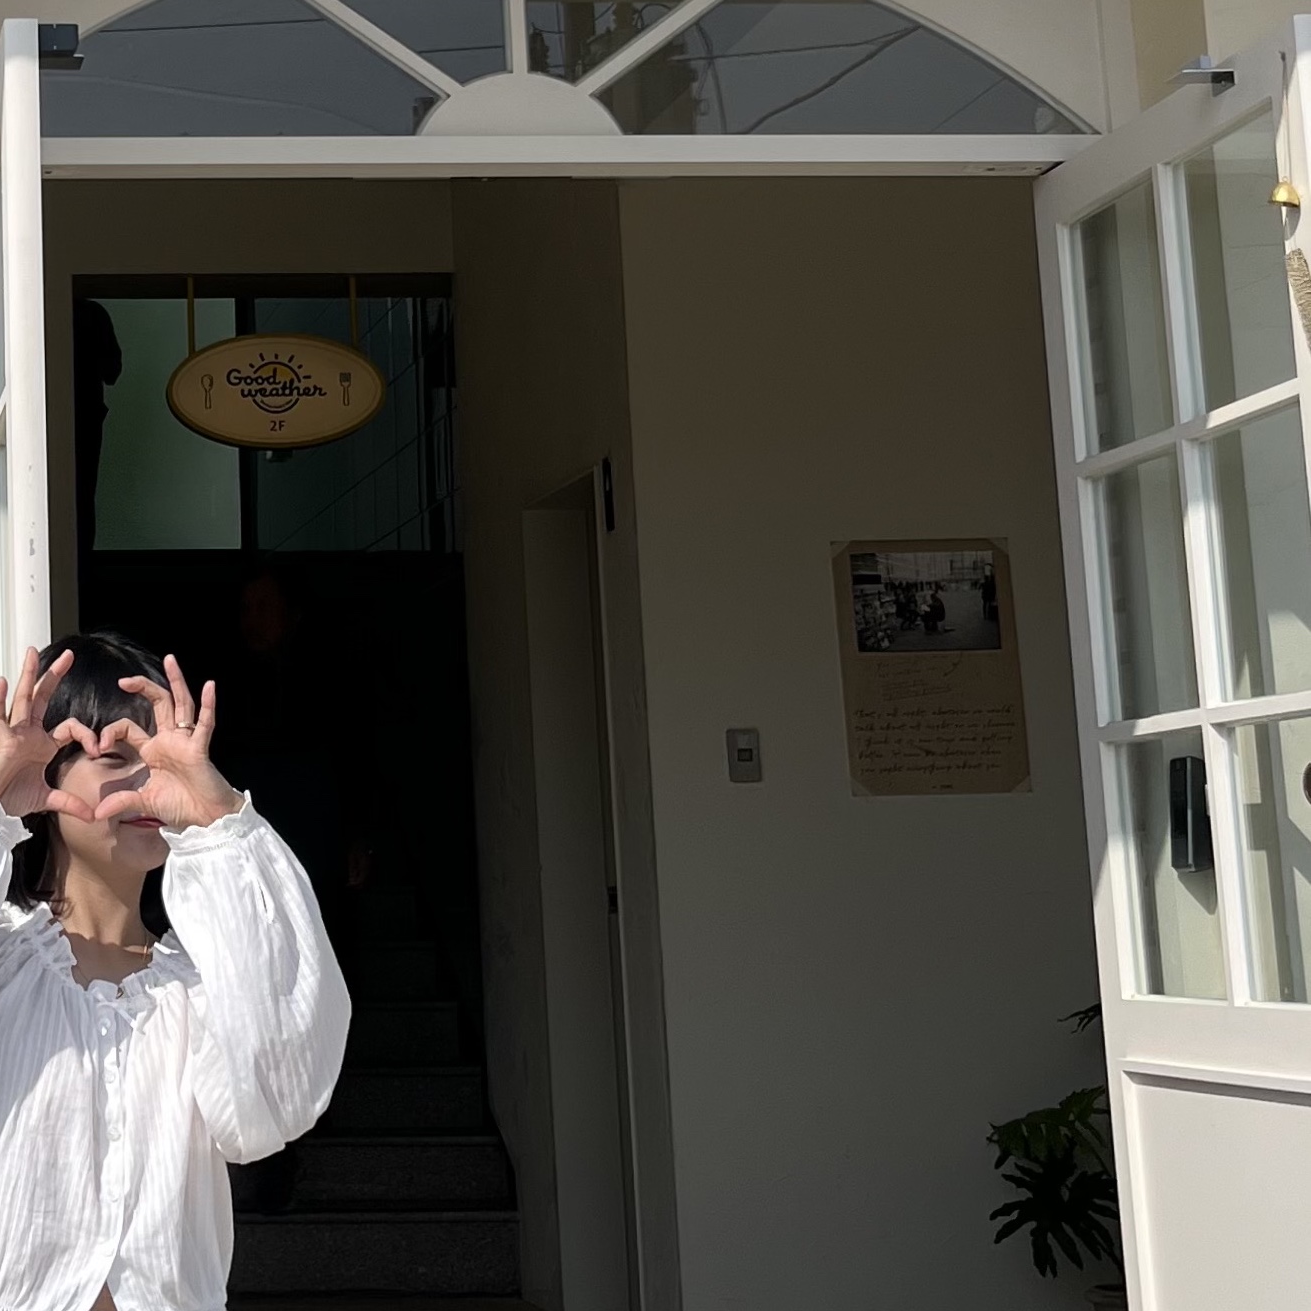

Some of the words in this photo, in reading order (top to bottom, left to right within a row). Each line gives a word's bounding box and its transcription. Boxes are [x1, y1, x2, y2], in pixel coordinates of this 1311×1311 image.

[226, 367, 280, 386] Good
[240, 380, 327, 398] weather
[269, 419, 287, 432] 2F
